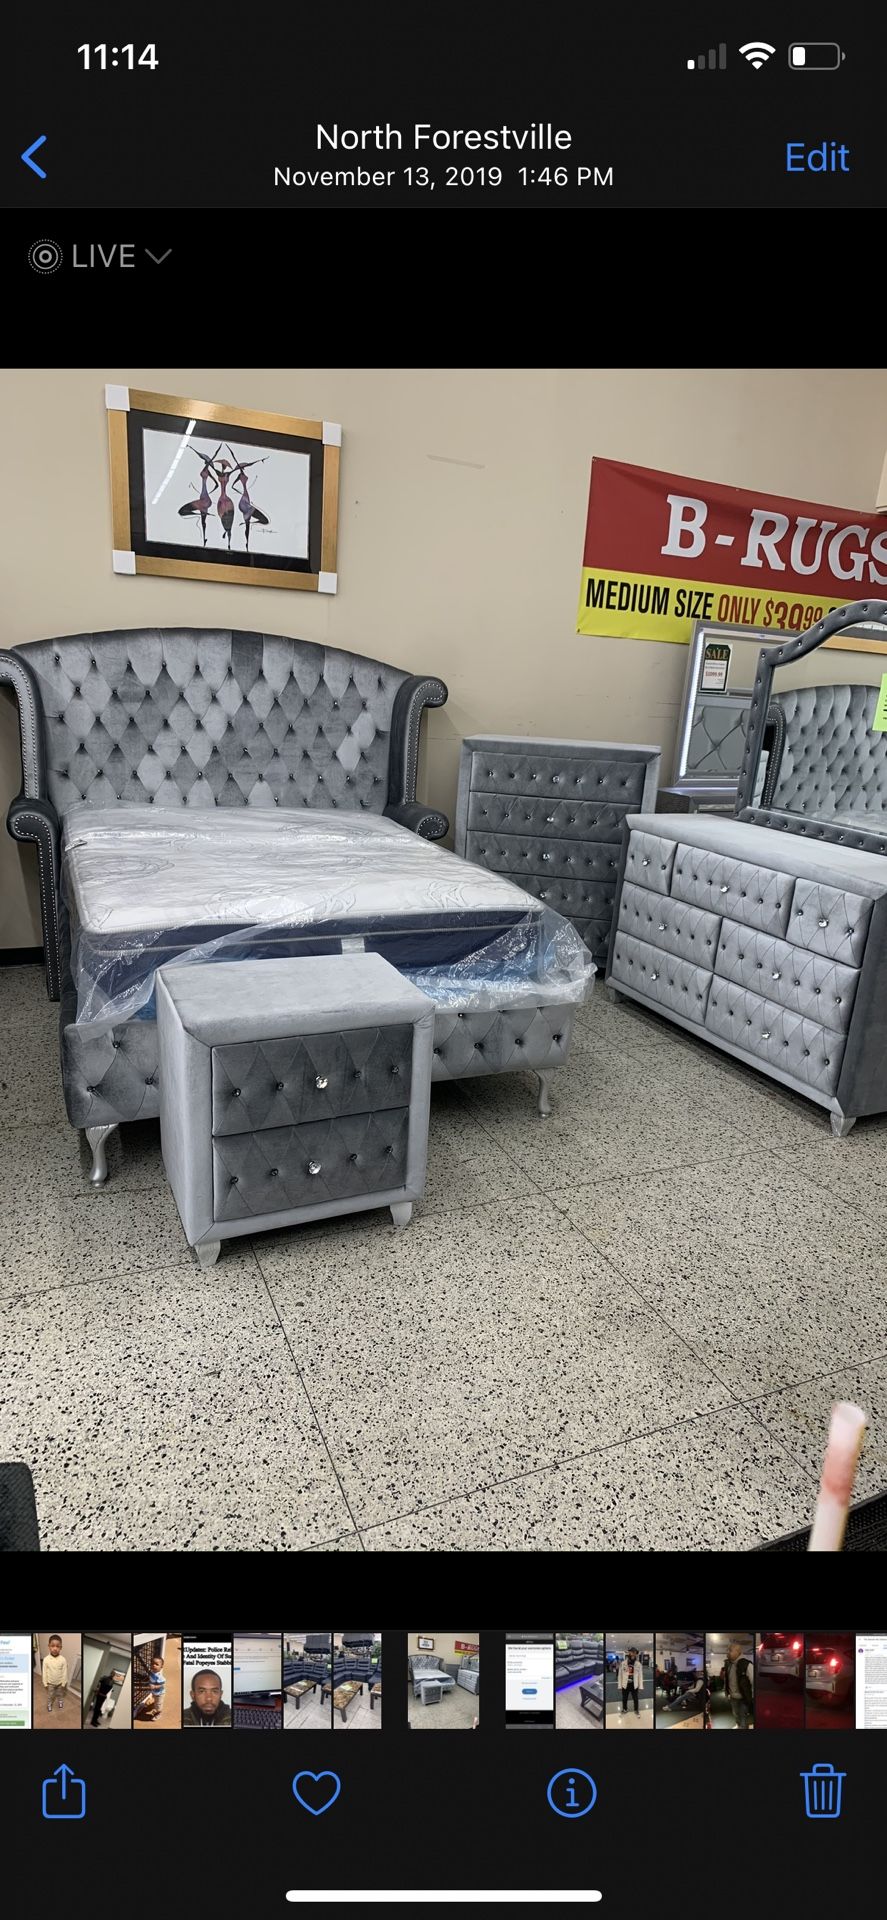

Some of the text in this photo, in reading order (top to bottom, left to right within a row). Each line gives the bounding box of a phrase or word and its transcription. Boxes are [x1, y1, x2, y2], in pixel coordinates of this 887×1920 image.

[78, 44, 159, 69] 11:14
[317, 123, 571, 149] North Forestville
[787, 141, 849, 172] Edit
[275, 166, 612, 190] November 13, 2019 1:46 PM
[73, 244, 134, 267] LIVE
[585, 578, 670, 614] MEDIUM
[674, 589, 714, 620] SIZE
[717, 594, 761, 625] ONLY
[705, 648, 729, 660] SALE
